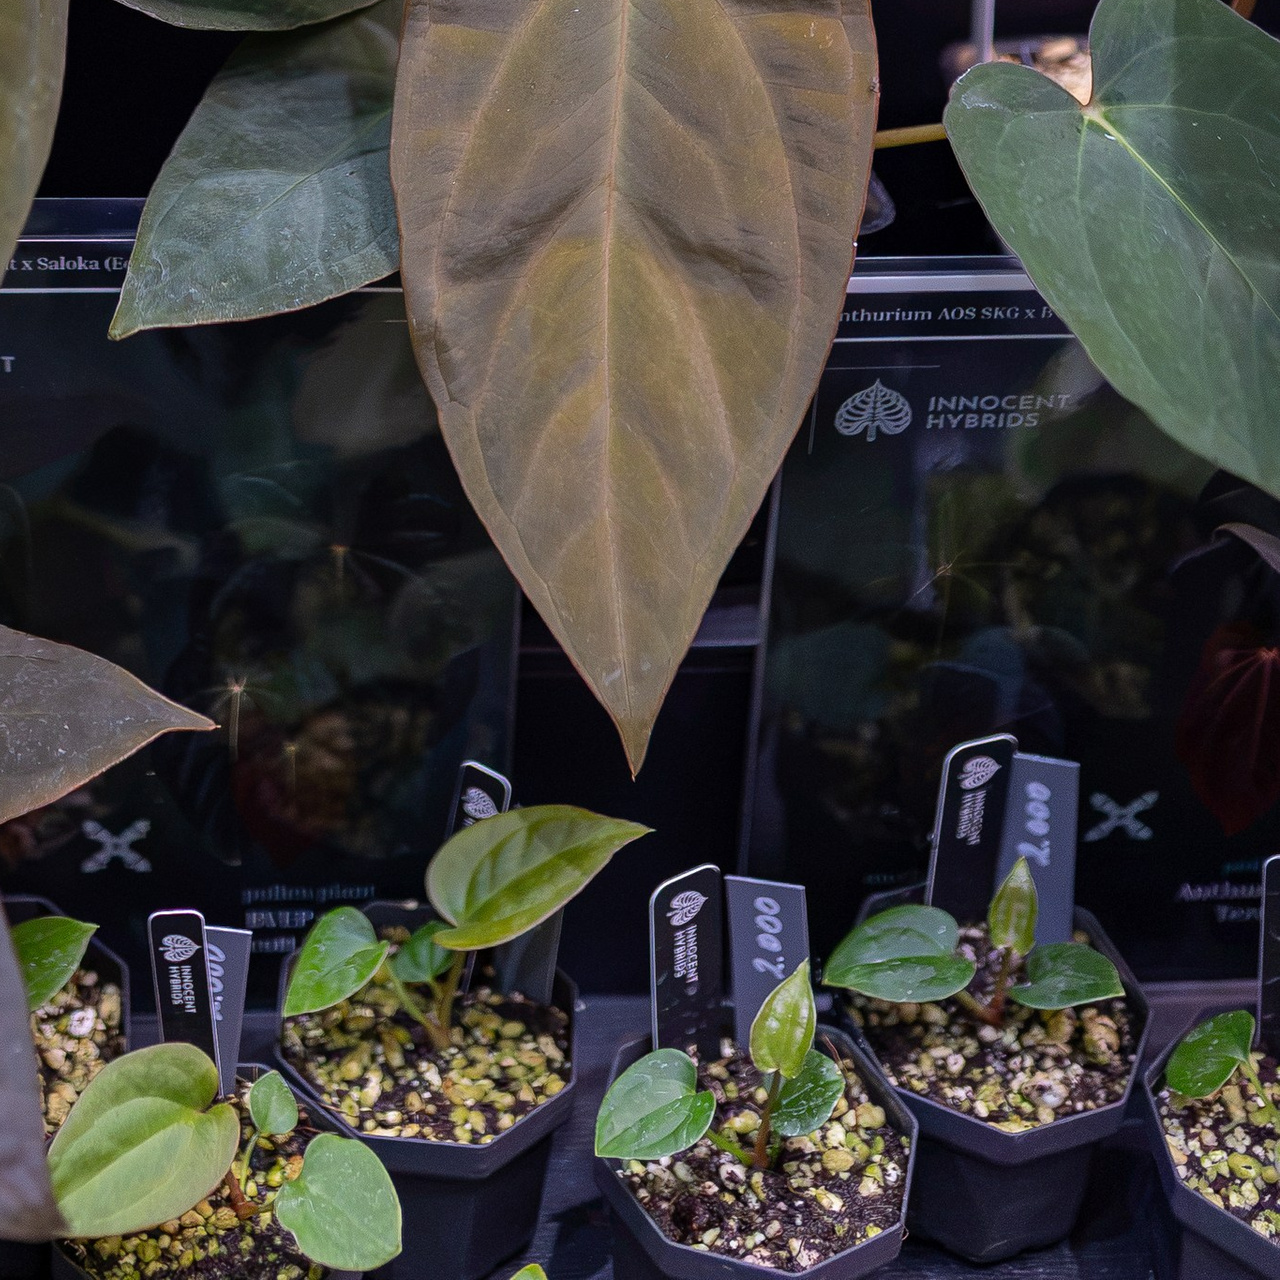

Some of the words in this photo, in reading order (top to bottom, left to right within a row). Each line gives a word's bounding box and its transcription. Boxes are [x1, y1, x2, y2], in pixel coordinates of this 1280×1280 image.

[20, 259, 34, 271] x
[36, 255, 101, 271] Saloka
[839, 307, 932, 322] nthurium
[937, 306, 977, 320] AOS
[980, 305, 1019, 320] SKG
[1023, 307, 1037, 320] x
[928, 393, 1070, 412] INNOCENT
[926, 412, 1040, 430] HYBRIDS
[673, 928, 687, 979] HYBRIDS
[685, 924, 699, 984] INNOCENT
[168, 965, 184, 1005] HYBRIDS
[180, 964, 197, 1014] INNOCENT
